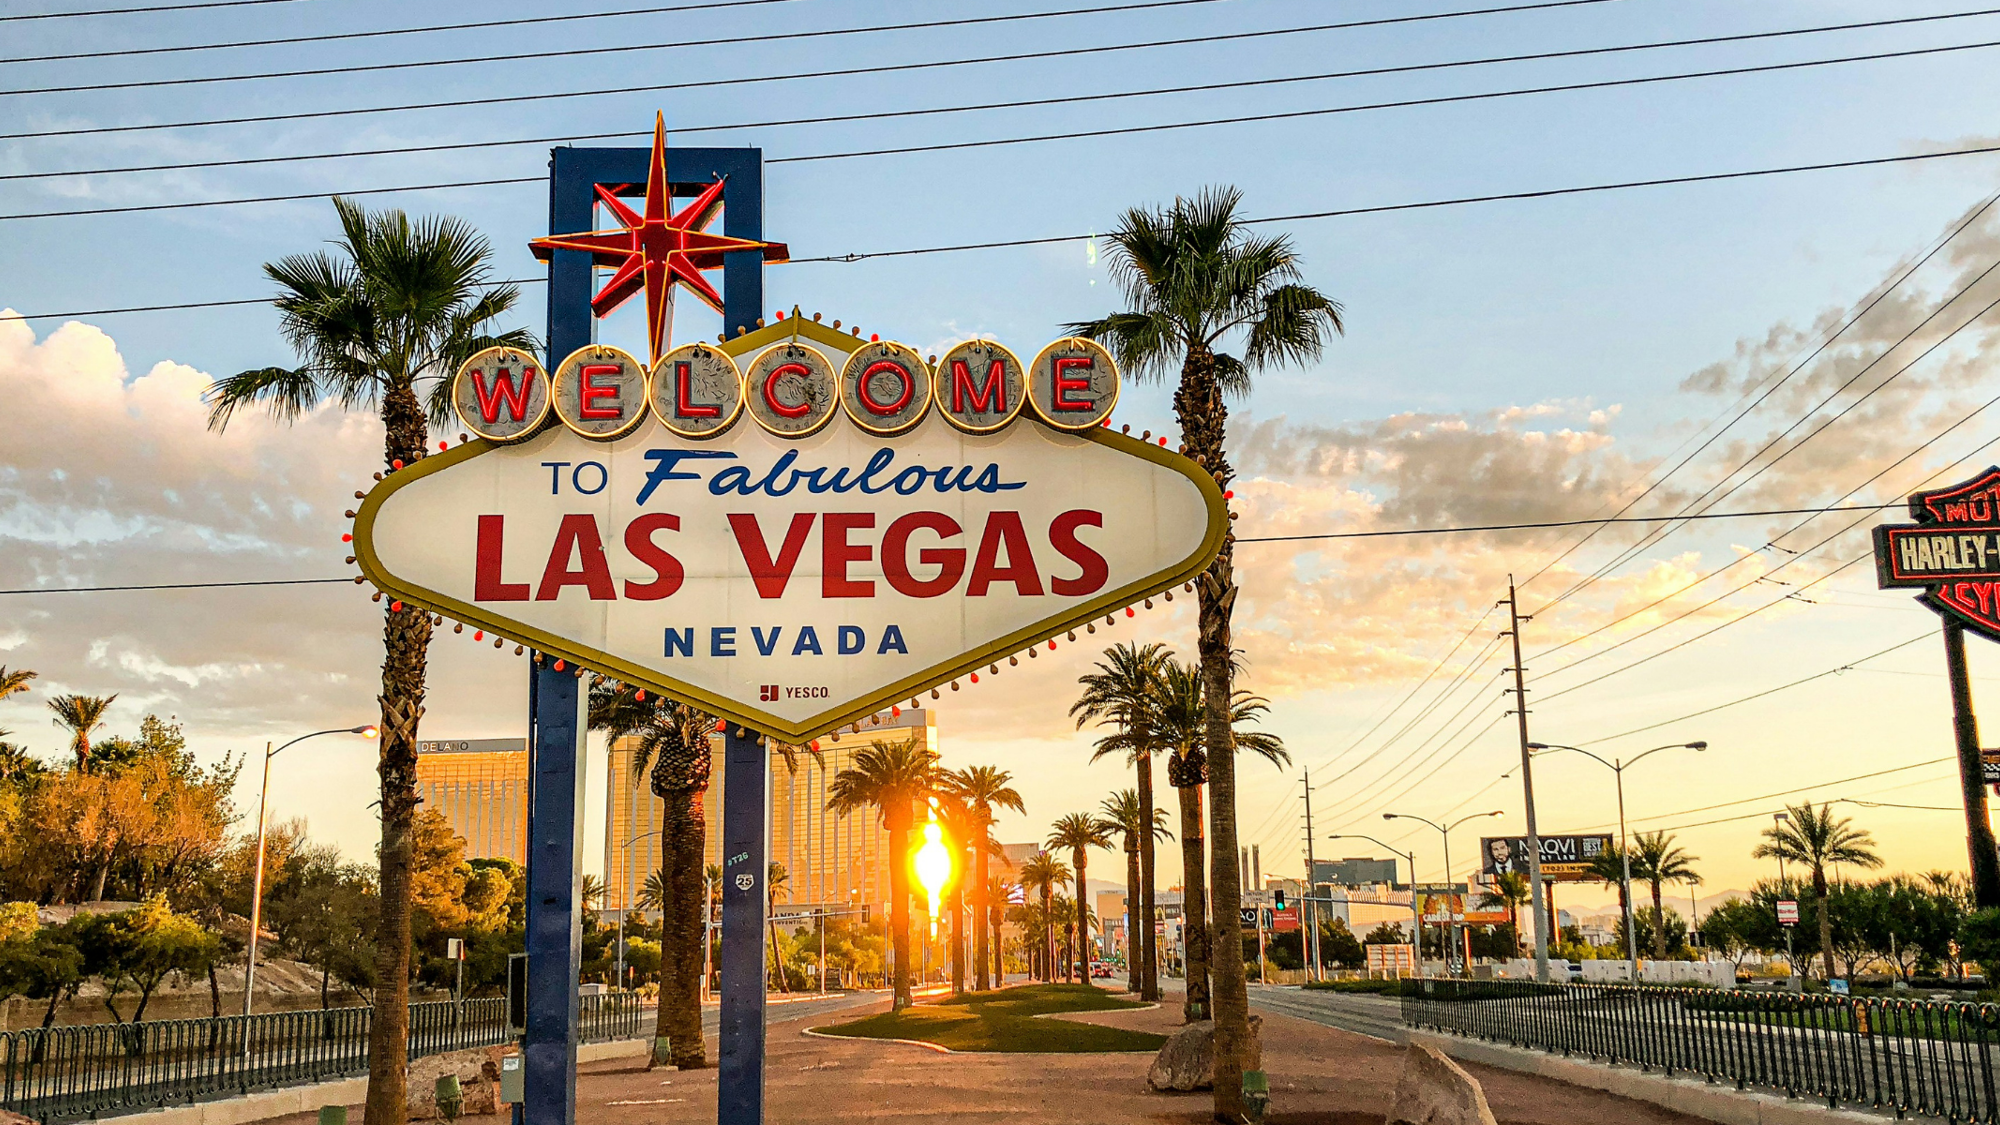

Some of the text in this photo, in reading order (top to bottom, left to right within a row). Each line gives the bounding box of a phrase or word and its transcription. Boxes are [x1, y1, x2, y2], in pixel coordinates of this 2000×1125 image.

[470, 356, 1096, 425] WELCOME
[541, 448, 1027, 506] TO Fabulous
[474, 509, 1109, 602] LAS VEGAS
[1901, 534, 2000, 570] HARLEY-
[664, 625, 909, 657] NEVADA
[785, 686, 829, 699] YESCO
[421, 741, 469, 752] DELANO
[737, 877, 753, 886] 25
